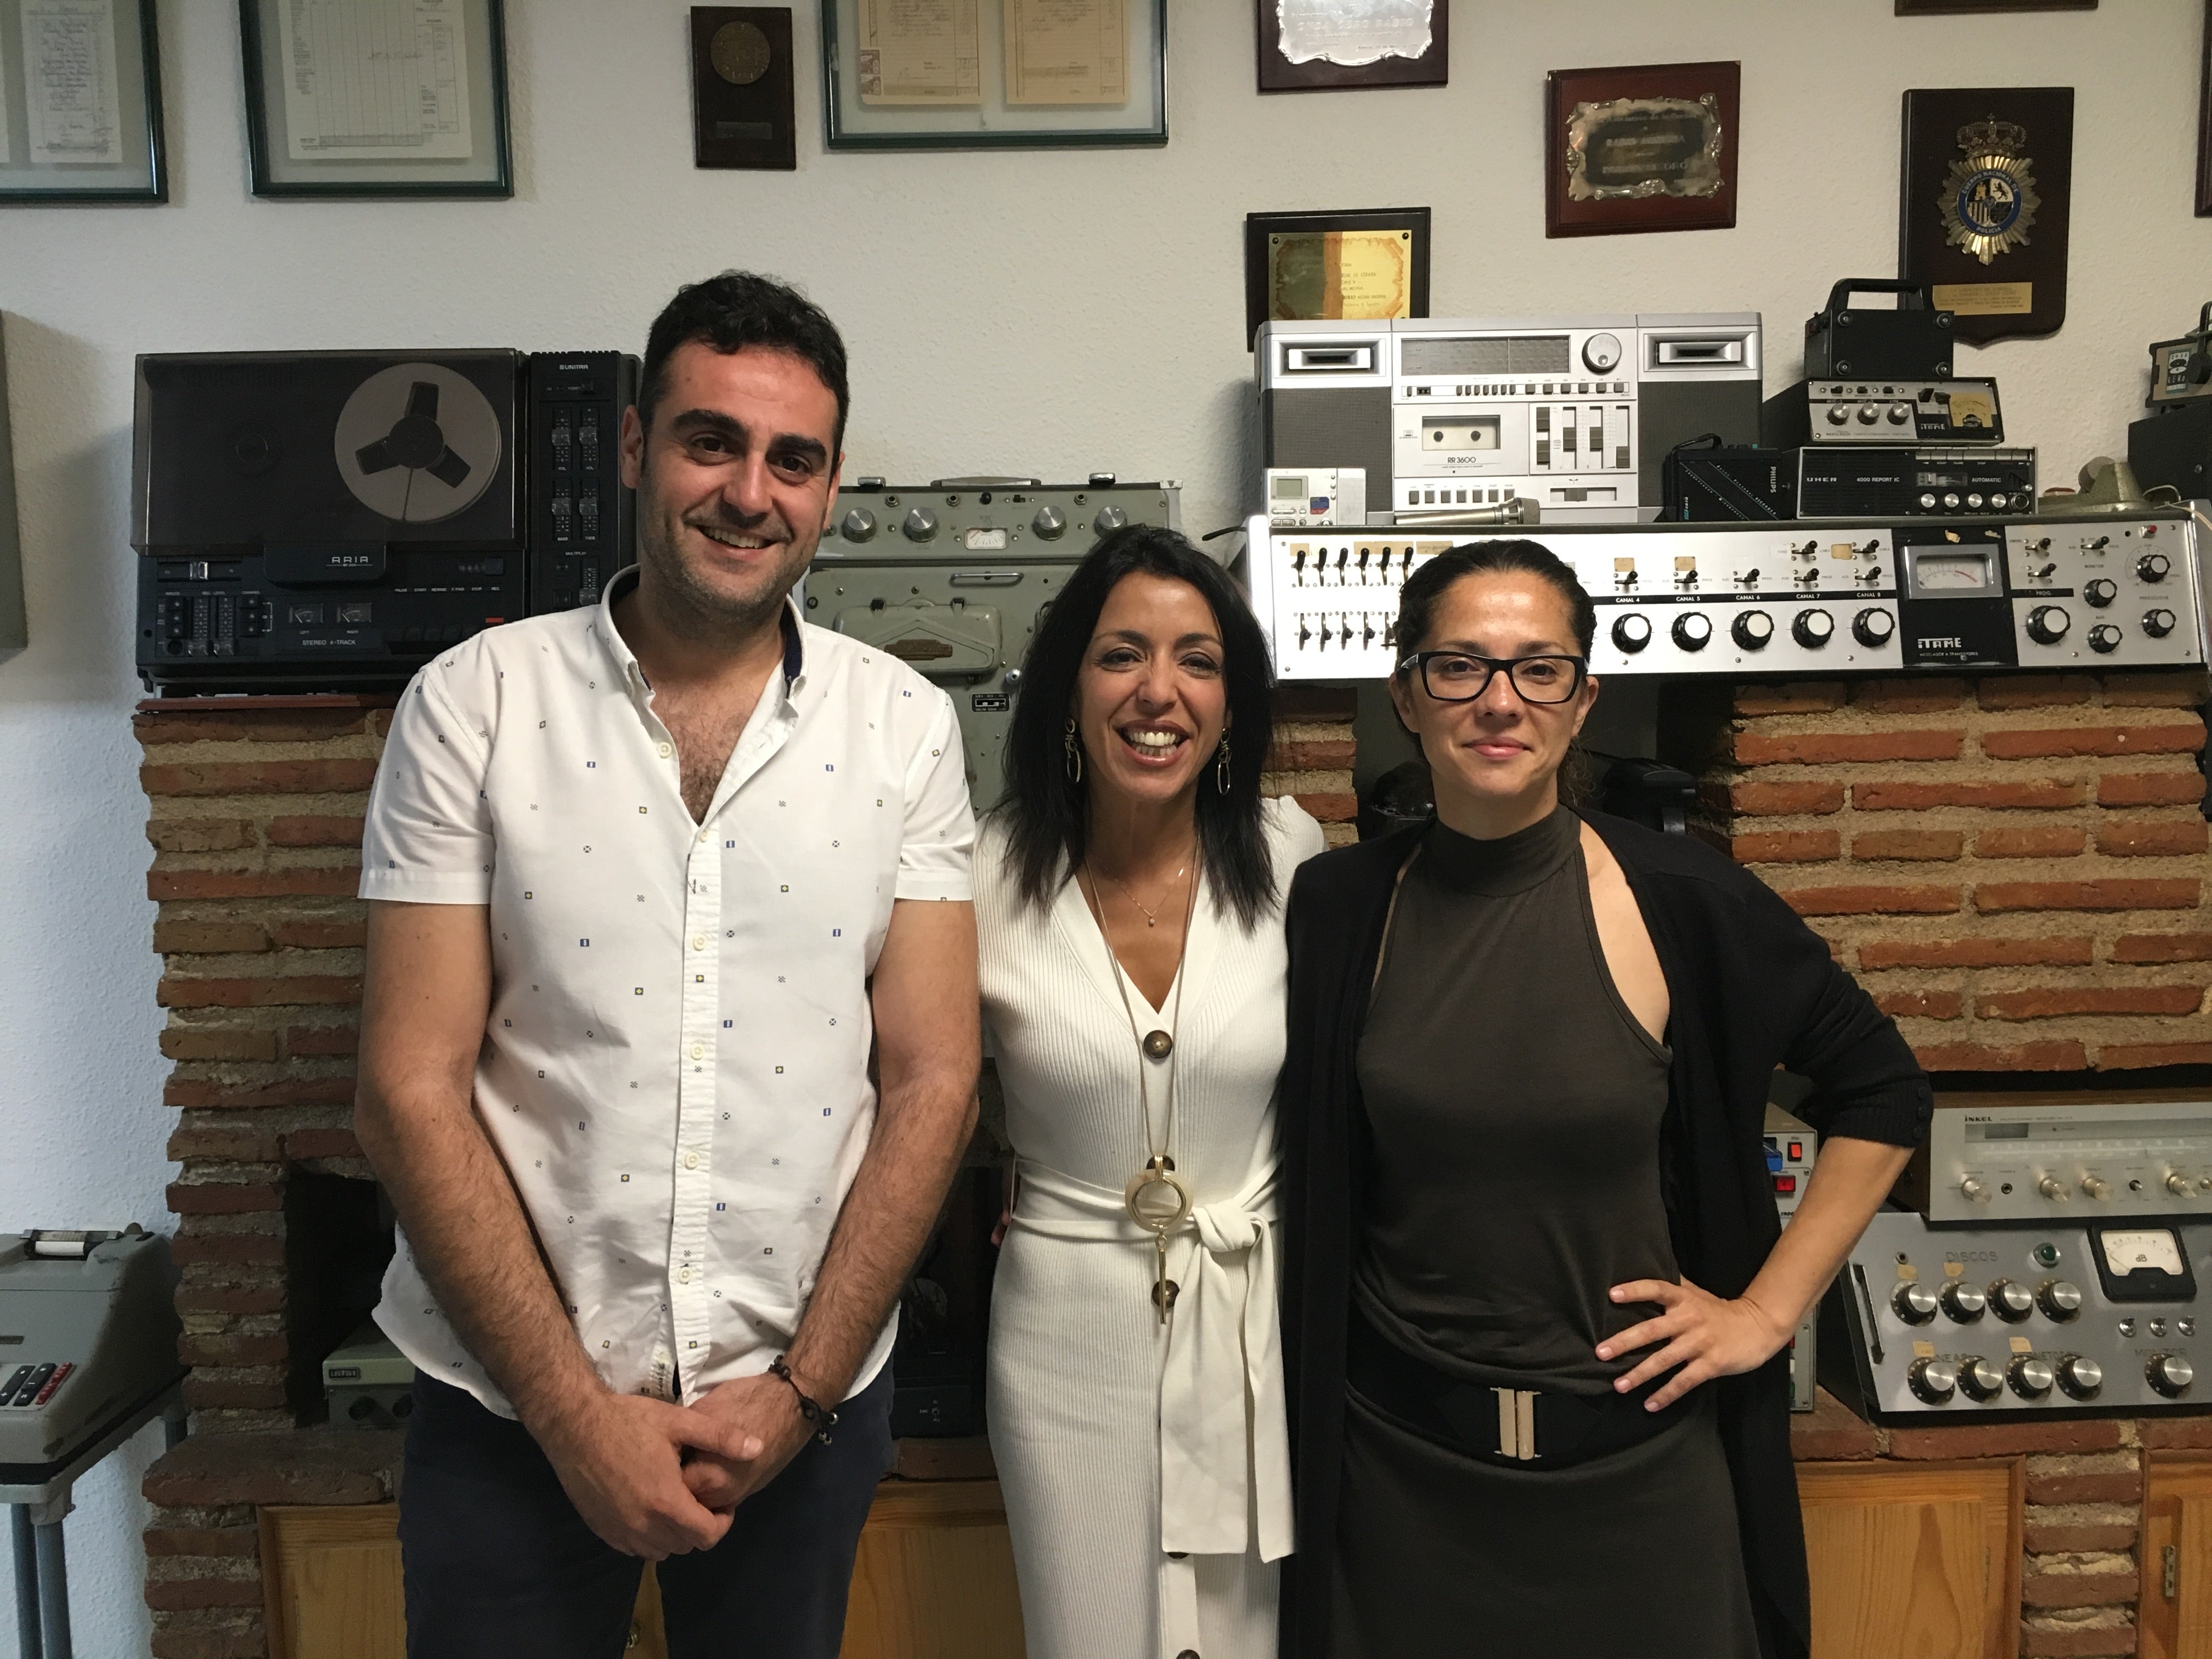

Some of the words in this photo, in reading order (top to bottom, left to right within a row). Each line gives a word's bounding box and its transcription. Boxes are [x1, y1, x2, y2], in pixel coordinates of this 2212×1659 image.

[1961, 174, 1982, 194] CUERPO
[1983, 171, 2012, 184] NACIONAL
[2012, 183, 2019, 194] DE
[1945, 1251, 1999, 1262] DISCOS
[2135, 1254, 2148, 1262] dB
